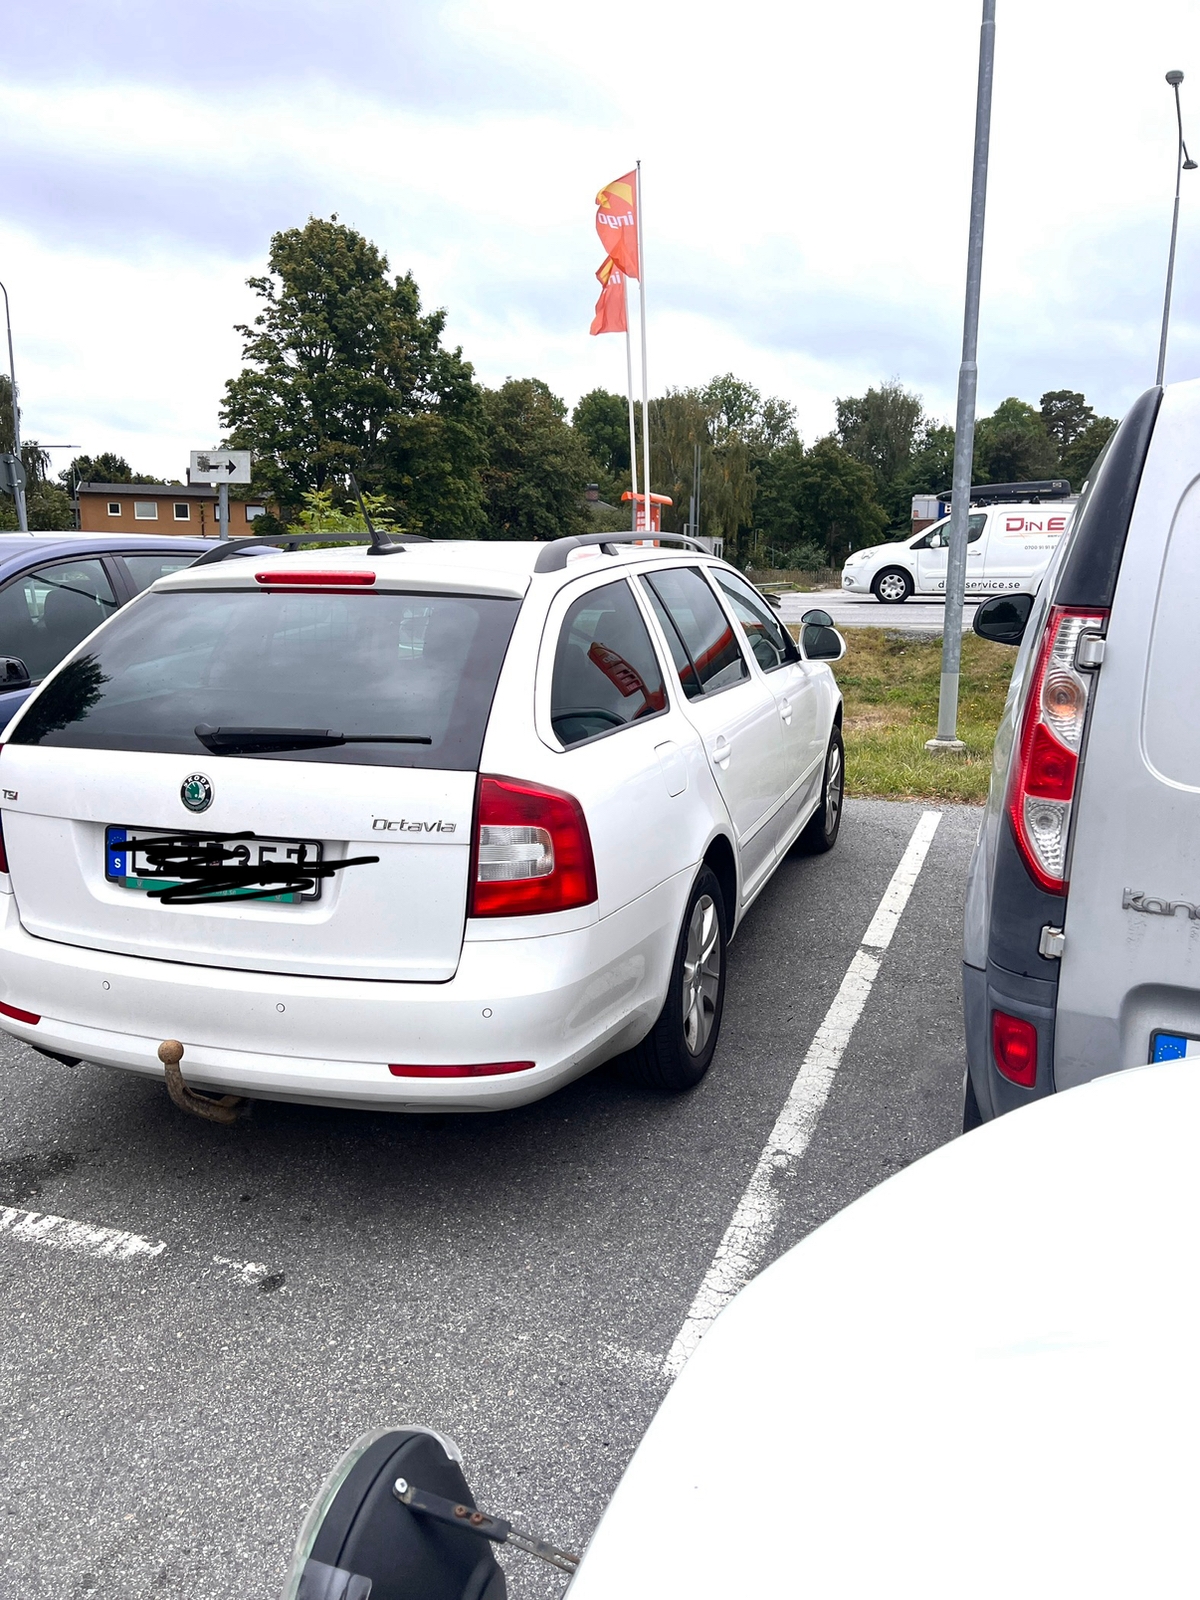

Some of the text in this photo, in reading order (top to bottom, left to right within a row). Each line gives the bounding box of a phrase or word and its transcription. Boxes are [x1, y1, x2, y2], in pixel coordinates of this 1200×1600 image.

[1047, 517, 1066, 531] E
[372, 819, 456, 833] Octavia
[114, 858, 121, 868] S
[1122, 886, 1200, 920] Kan
